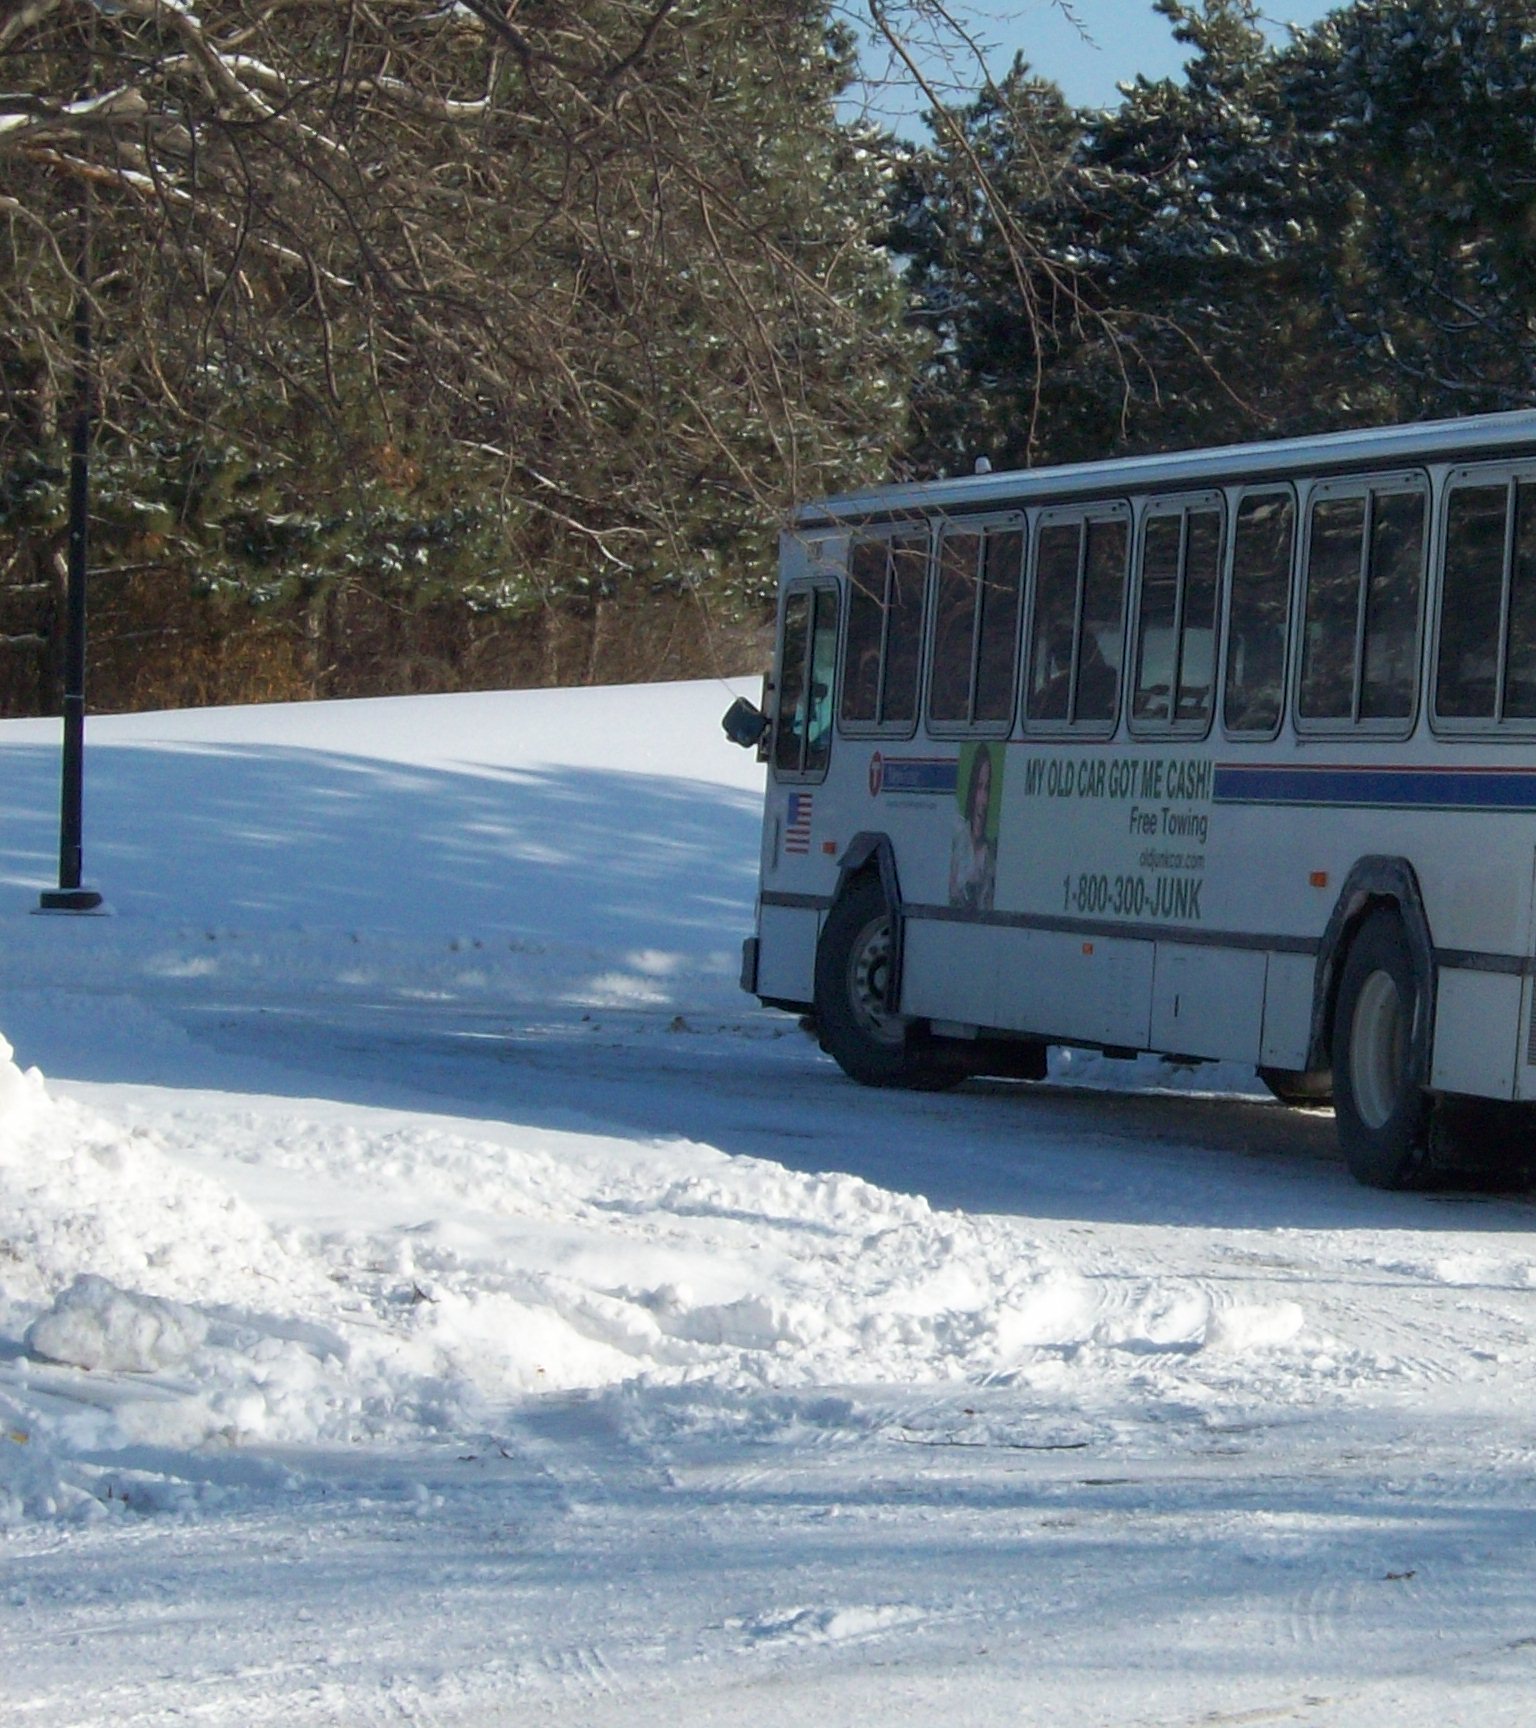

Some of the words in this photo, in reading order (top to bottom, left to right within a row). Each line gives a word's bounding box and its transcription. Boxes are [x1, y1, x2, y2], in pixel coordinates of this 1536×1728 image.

[1025, 758, 1046, 796] MY
[1048, 758, 1074, 797] OLD
[1078, 759, 1106, 797] CAR
[1108, 759, 1139, 799] GOT
[1141, 759, 1163, 799] ME
[1166, 759, 1212, 800] CASH!
[1129, 806, 1158, 835] Free
[1161, 807, 1209, 844] Towing
[1063, 874, 1203, 920] 1-800-300-JUNK
